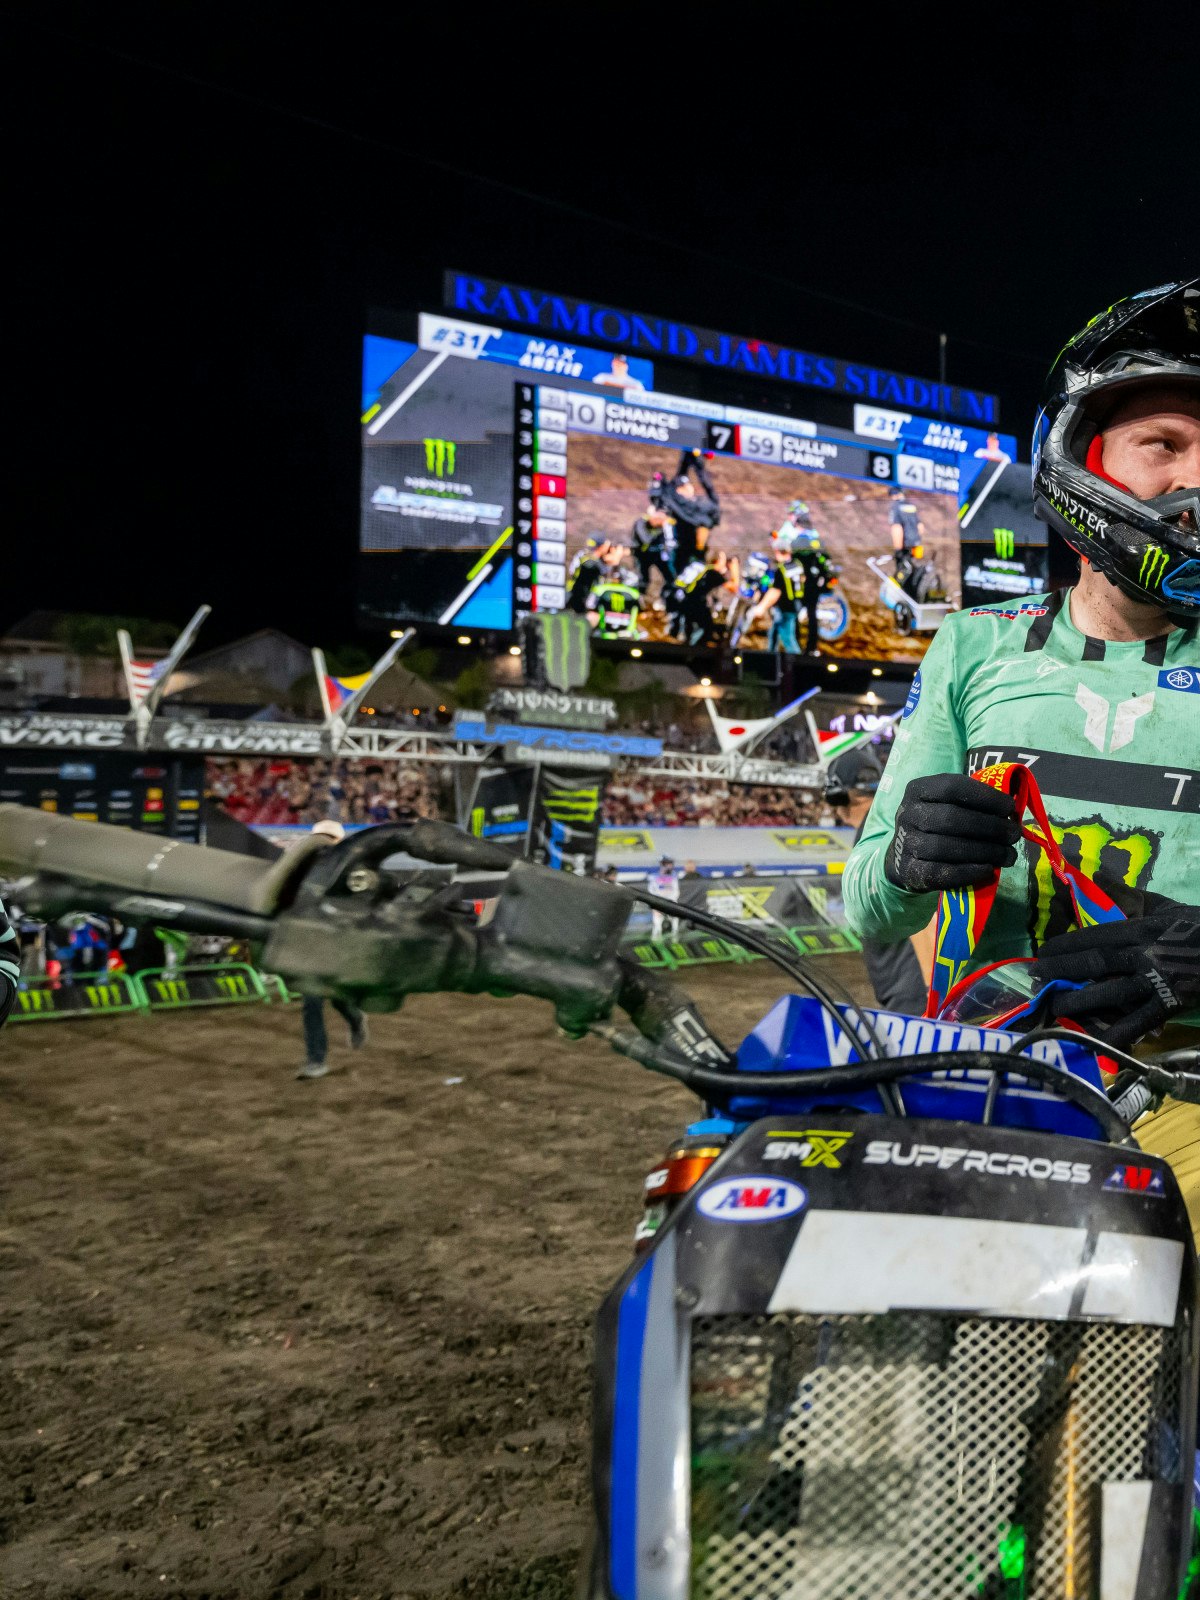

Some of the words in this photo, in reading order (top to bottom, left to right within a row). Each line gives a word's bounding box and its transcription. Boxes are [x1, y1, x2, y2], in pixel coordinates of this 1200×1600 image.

[455, 275, 699, 356] RAYMOND
[704, 335, 836, 388] JAMES
[844, 364, 994, 422] STADIUM
[527, 340, 577, 362] MAX
[605, 403, 680, 430] CHANCE
[605, 420, 669, 443] HYMAS
[711, 425, 732, 449] 7
[927, 422, 963, 440] MAX
[749, 433, 775, 456] 59
[783, 435, 838, 459] CULLIN
[783, 449, 826, 470] PARK
[872, 456, 891, 478] 8
[905, 464, 927, 484] 41
[1040, 473, 1108, 539] MONSTER
[1050, 498, 1094, 539] ENERGY
[503, 689, 618, 719] MONSTER
[454, 721, 664, 757] SUPERCROSS
[1145, 968, 1178, 1008] THOR
[762, 1136, 848, 1169] SMX
[862, 1141, 1092, 1185] SUPERCROSS
[1102, 1164, 1166, 1195] AMA
[716, 1186, 789, 1210] AMA
